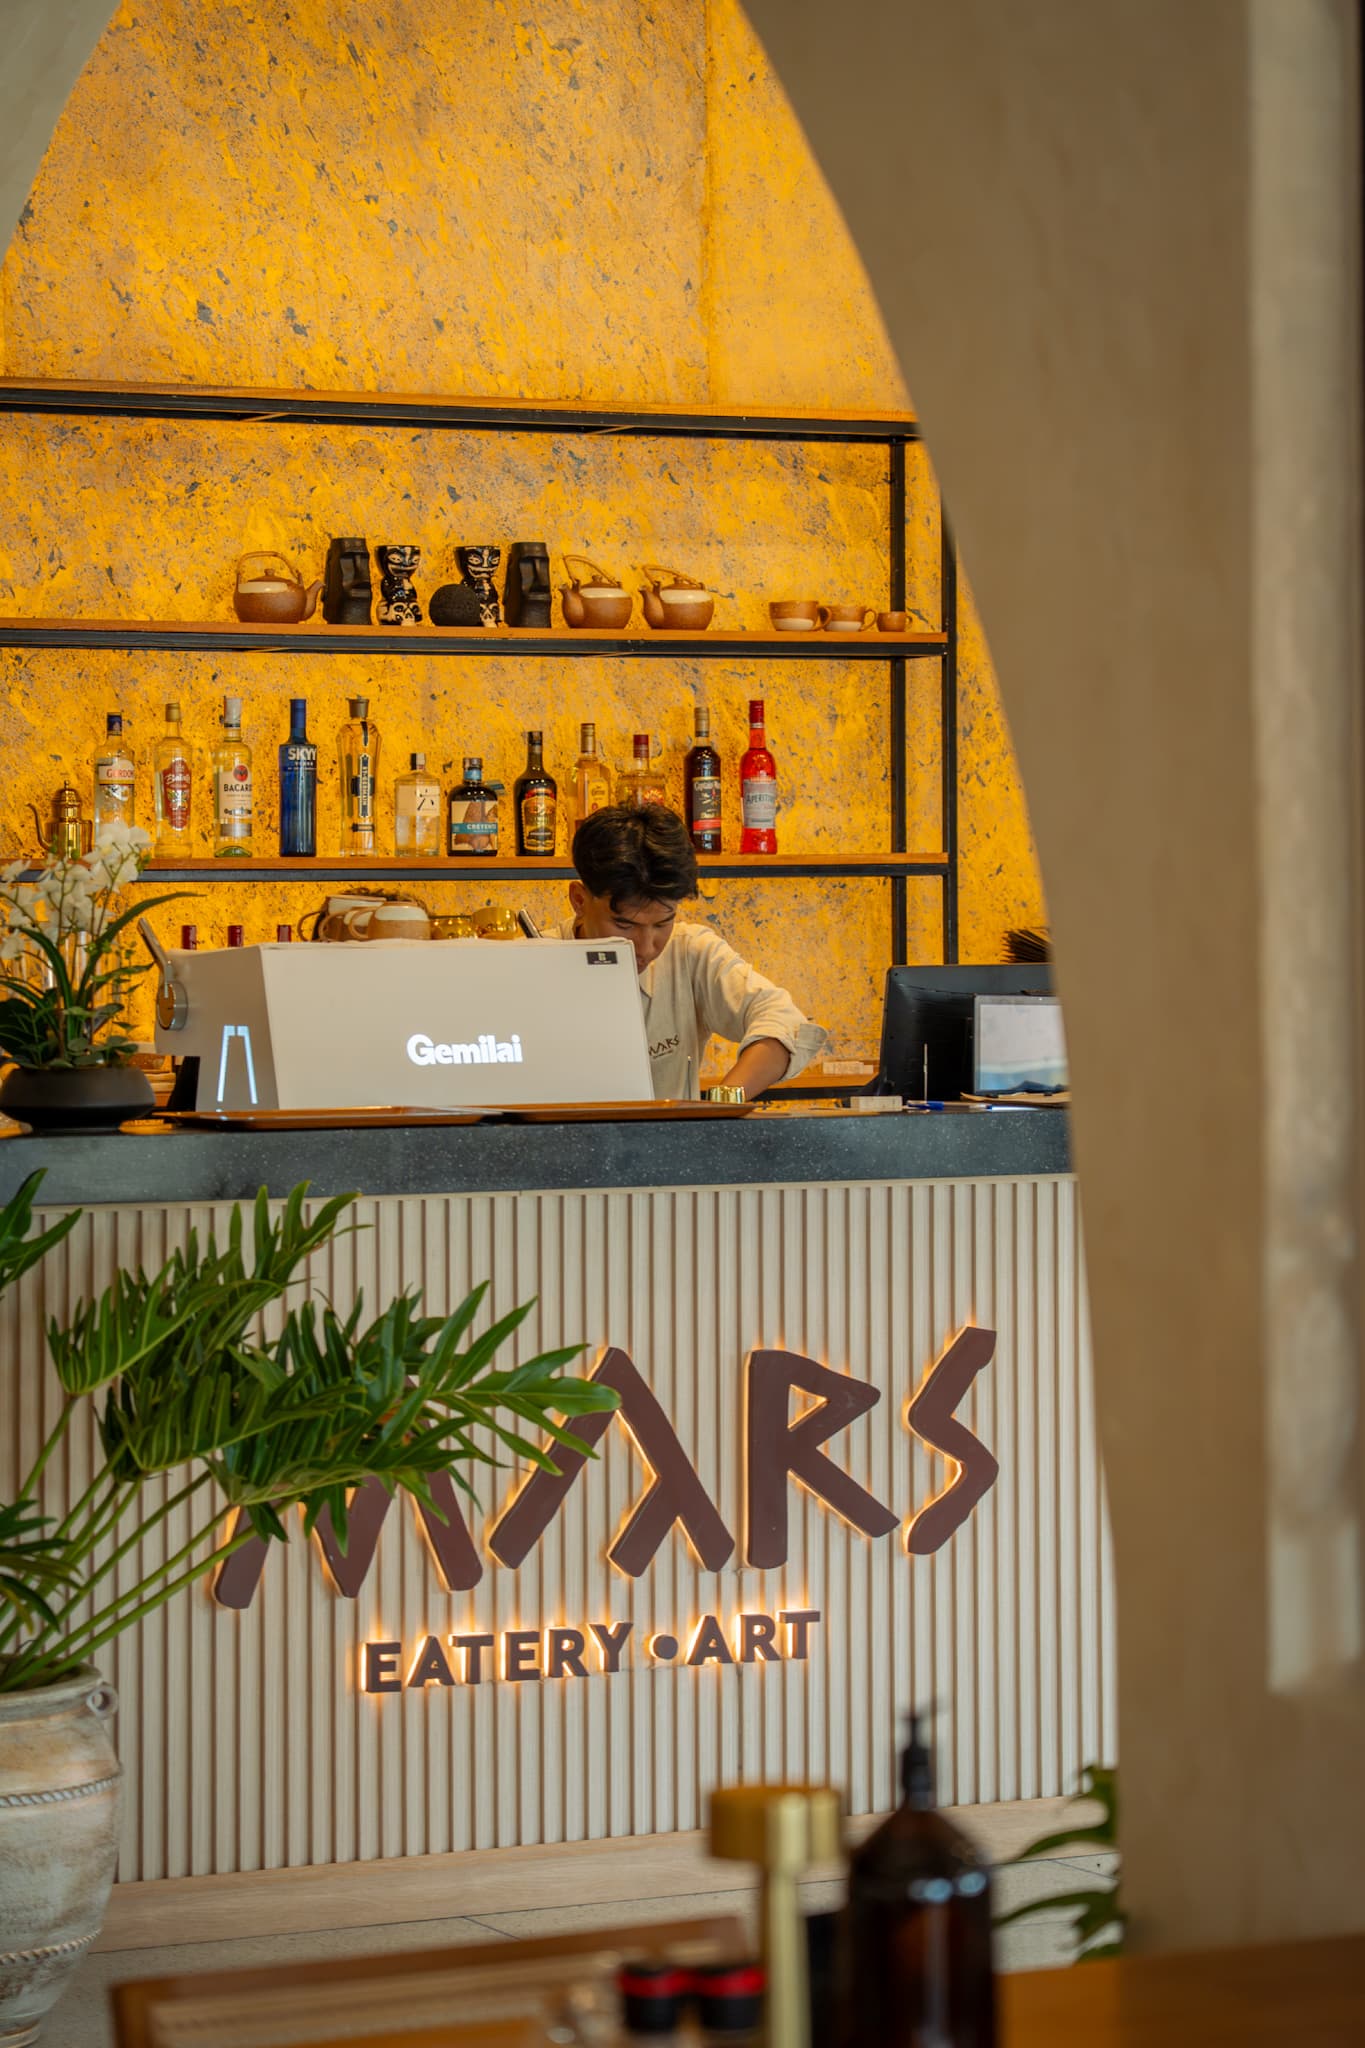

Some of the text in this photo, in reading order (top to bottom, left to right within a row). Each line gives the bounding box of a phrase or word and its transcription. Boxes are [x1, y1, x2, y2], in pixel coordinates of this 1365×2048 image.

[287, 747, 317, 761] SKYY
[406, 1033, 523, 1066] Gemilai
[363, 1609, 821, 1693] EATERY ART
